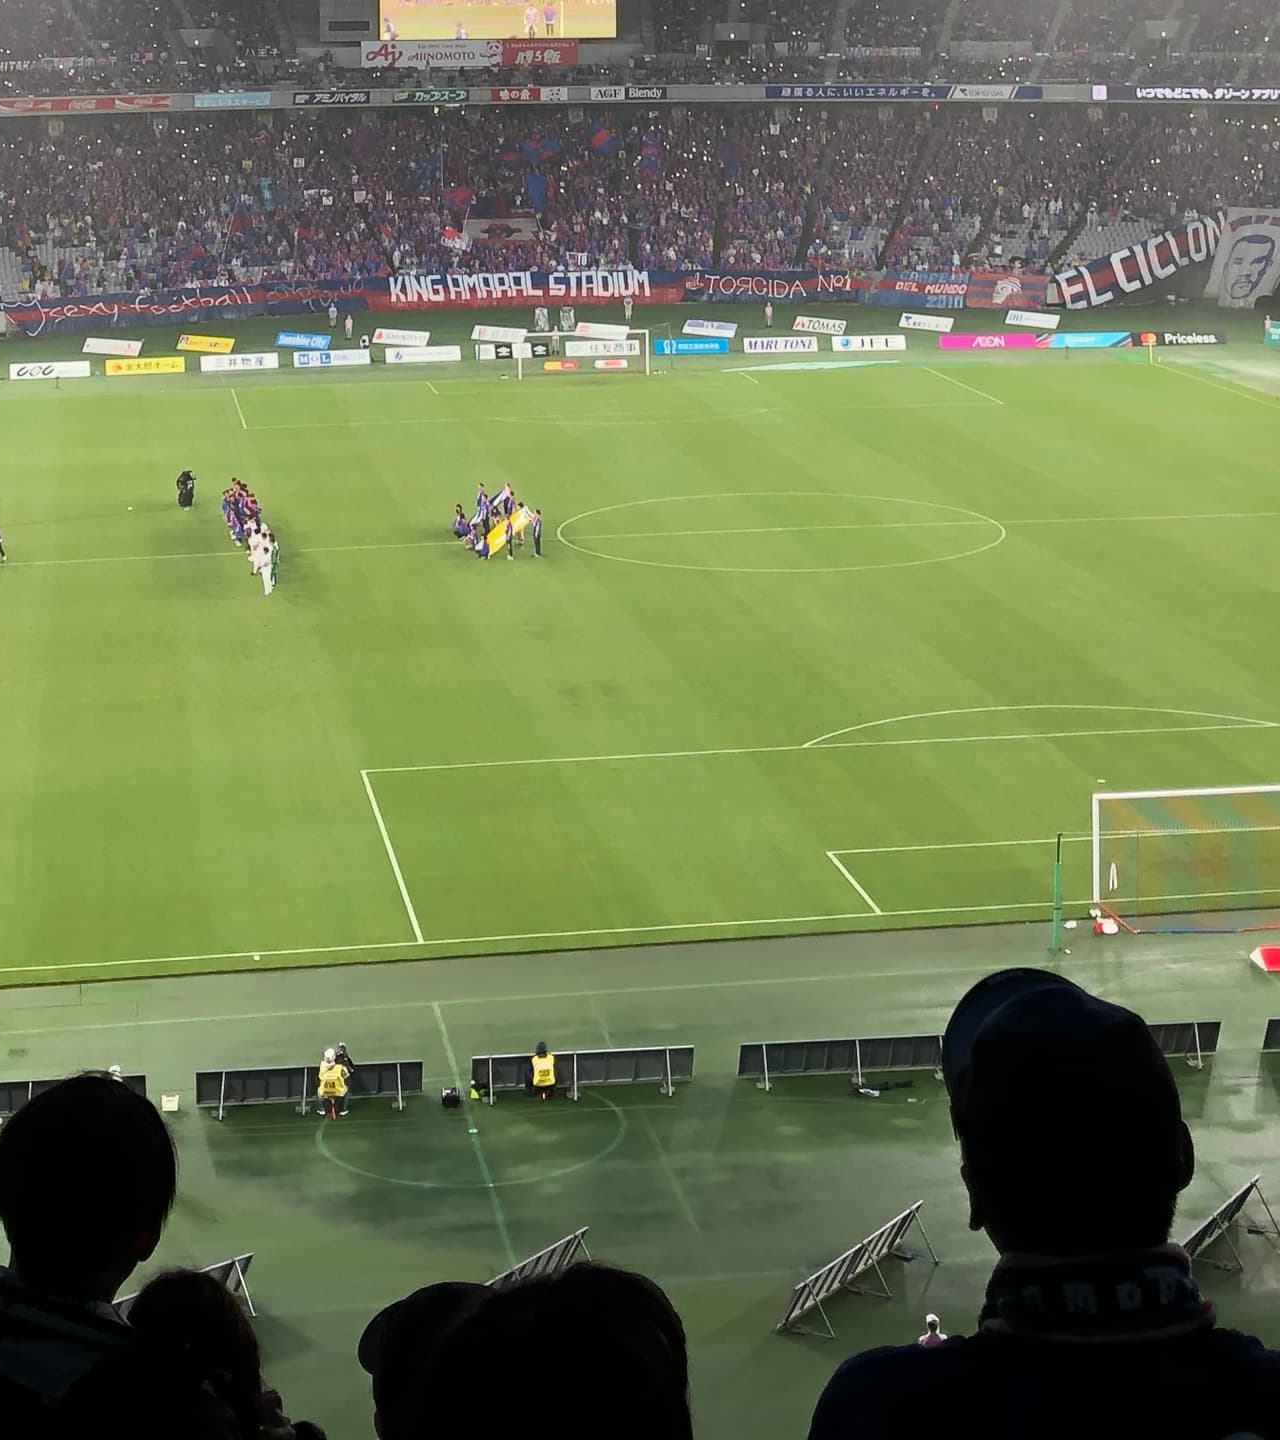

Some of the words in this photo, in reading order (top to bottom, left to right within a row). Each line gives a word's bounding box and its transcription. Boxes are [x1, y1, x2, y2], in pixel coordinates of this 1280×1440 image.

[629, 87, 662, 99] Blendy
[388, 275, 445, 303] KING
[448, 270, 543, 300] AMARAL
[548, 269, 651, 298] STADIUM
[895, 281, 919, 292] DEL
[924, 283, 968, 295] MUNDO
[1055, 266, 1113, 309] EL
[806, 319, 845, 333] TOMAS
